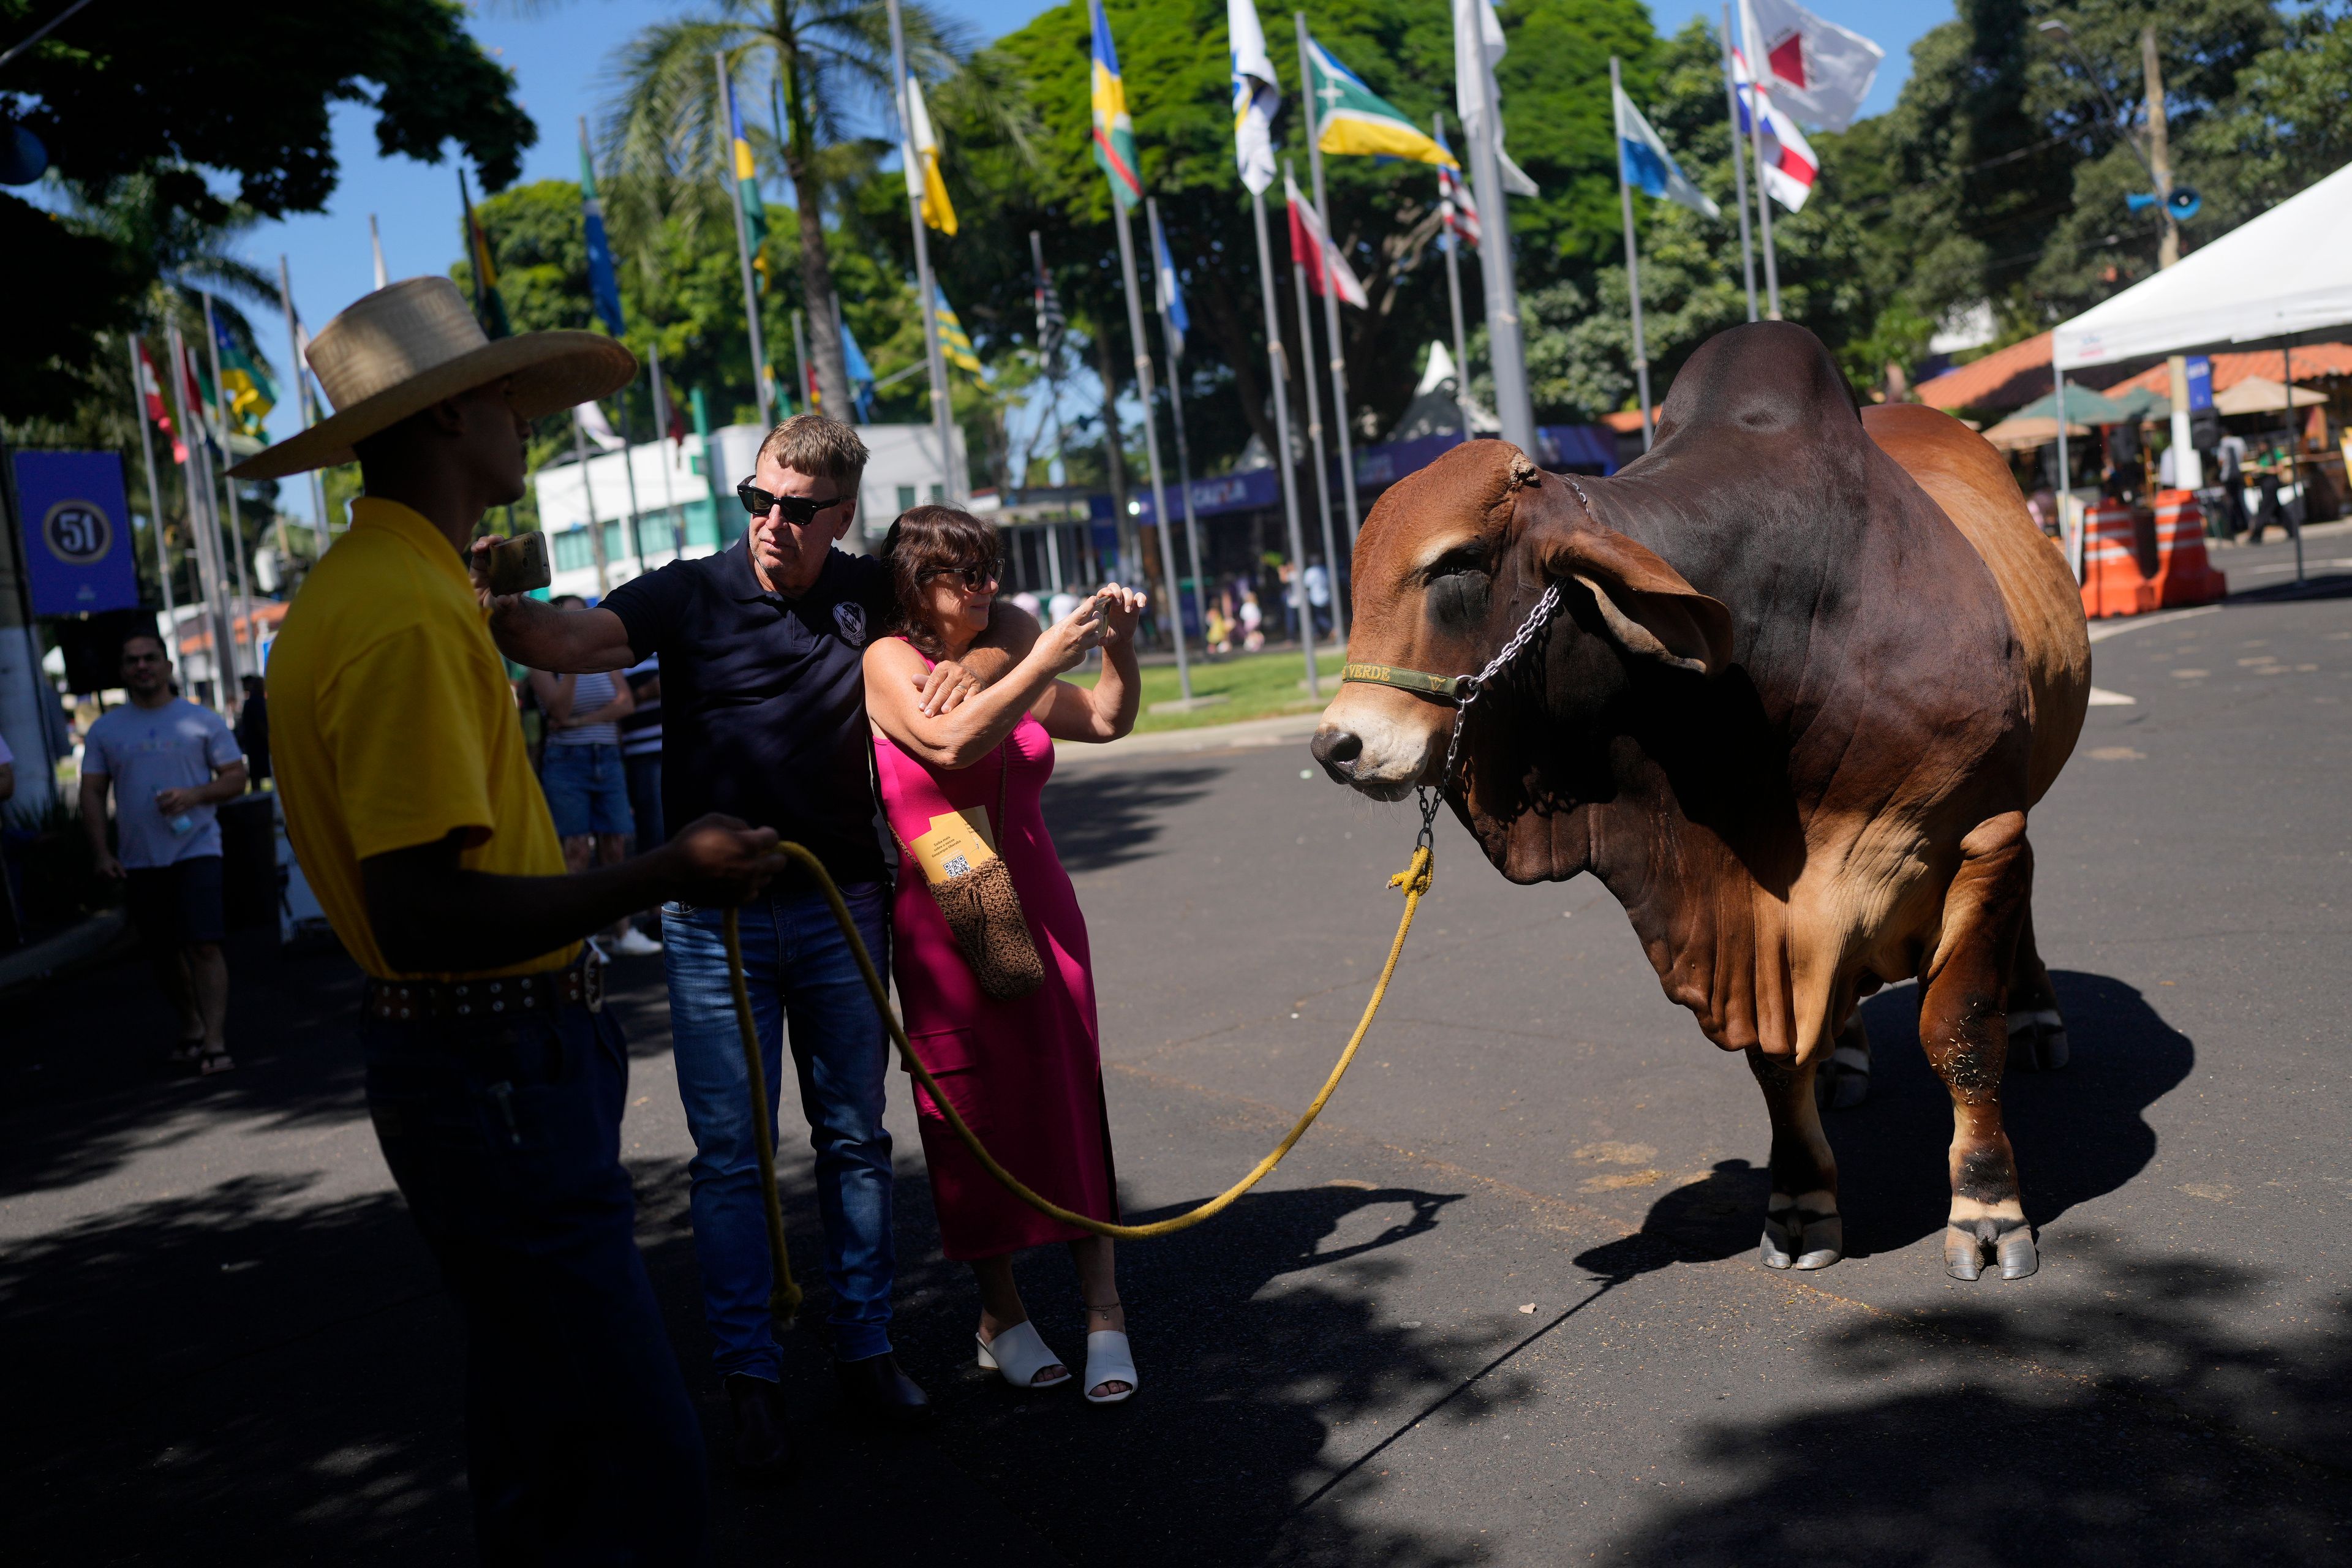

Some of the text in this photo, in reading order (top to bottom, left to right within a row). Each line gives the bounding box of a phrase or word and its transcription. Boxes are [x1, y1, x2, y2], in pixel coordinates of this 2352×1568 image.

[59, 513, 97, 552] 51
[1349, 664, 1392, 682] VERDE
[932, 847, 948, 858] Geoparque
[948, 840, 961, 849] Uberaba
